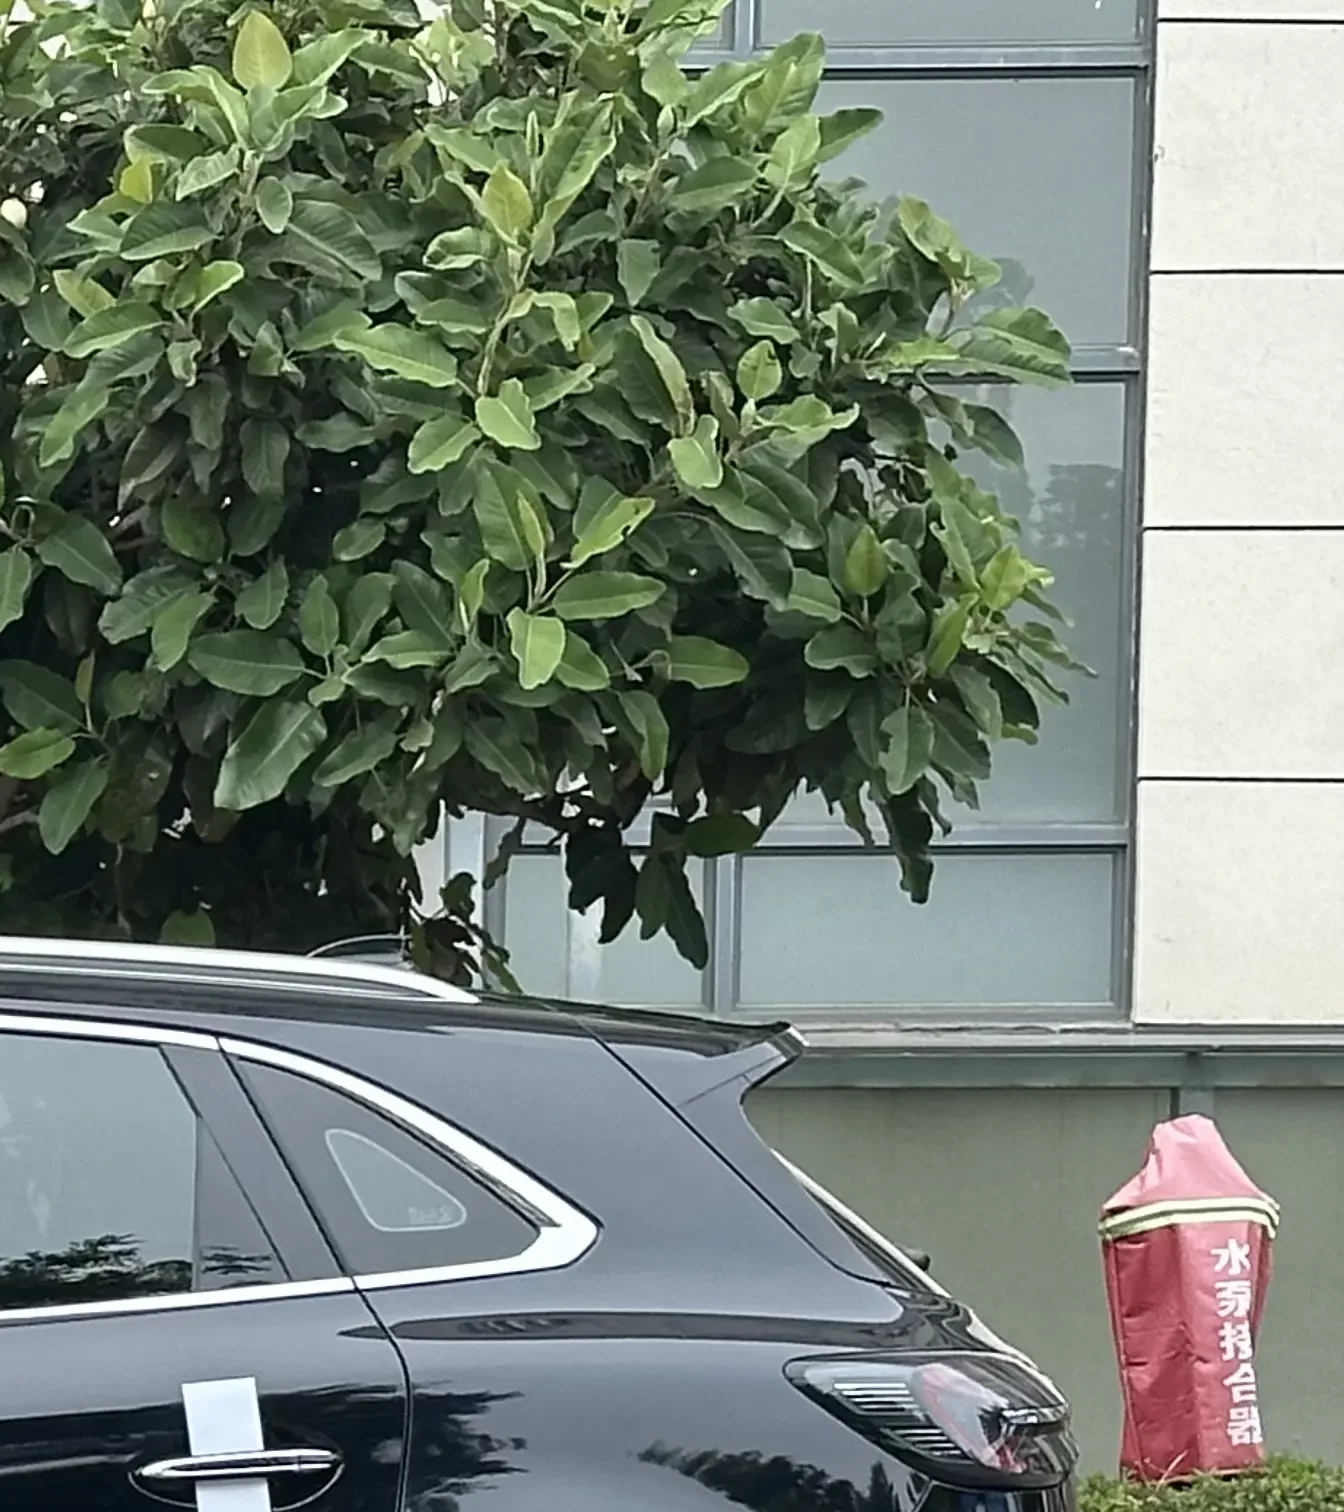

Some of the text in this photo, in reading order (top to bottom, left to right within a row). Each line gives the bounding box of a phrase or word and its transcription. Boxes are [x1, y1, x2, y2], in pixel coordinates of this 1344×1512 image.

[1210, 1238, 1264, 1447] 水泵接合器
